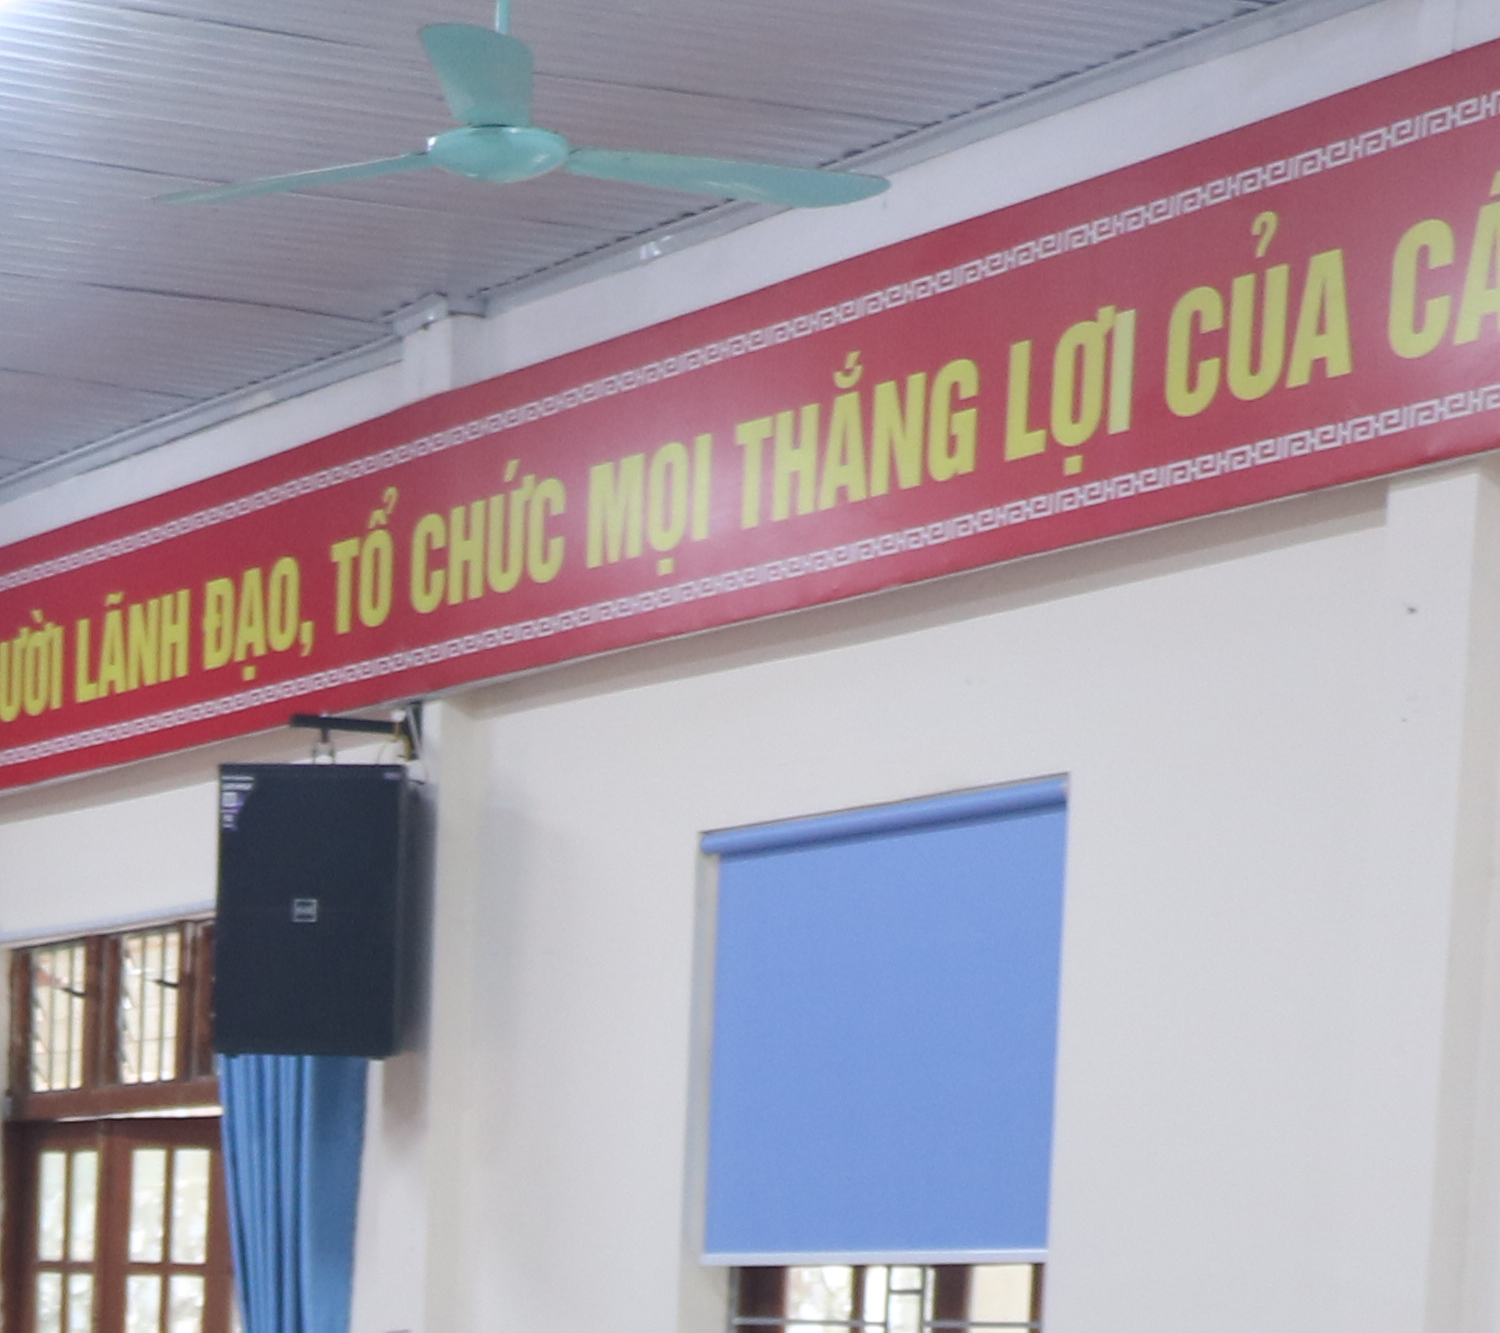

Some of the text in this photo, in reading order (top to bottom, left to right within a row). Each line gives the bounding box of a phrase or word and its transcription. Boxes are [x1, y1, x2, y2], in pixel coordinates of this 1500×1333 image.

[74, 587, 193, 704] LÃNH
[200, 554, 316, 682] ĐẠO,
[330, 485, 399, 635] TỔ
[408, 459, 567, 614] CHỨC
[586, 433, 713, 575] MỌI
[735, 349, 982, 528] THẮNG
[1003, 304, 1138, 476] LỢI
[1164, 209, 1354, 418] CỦA
